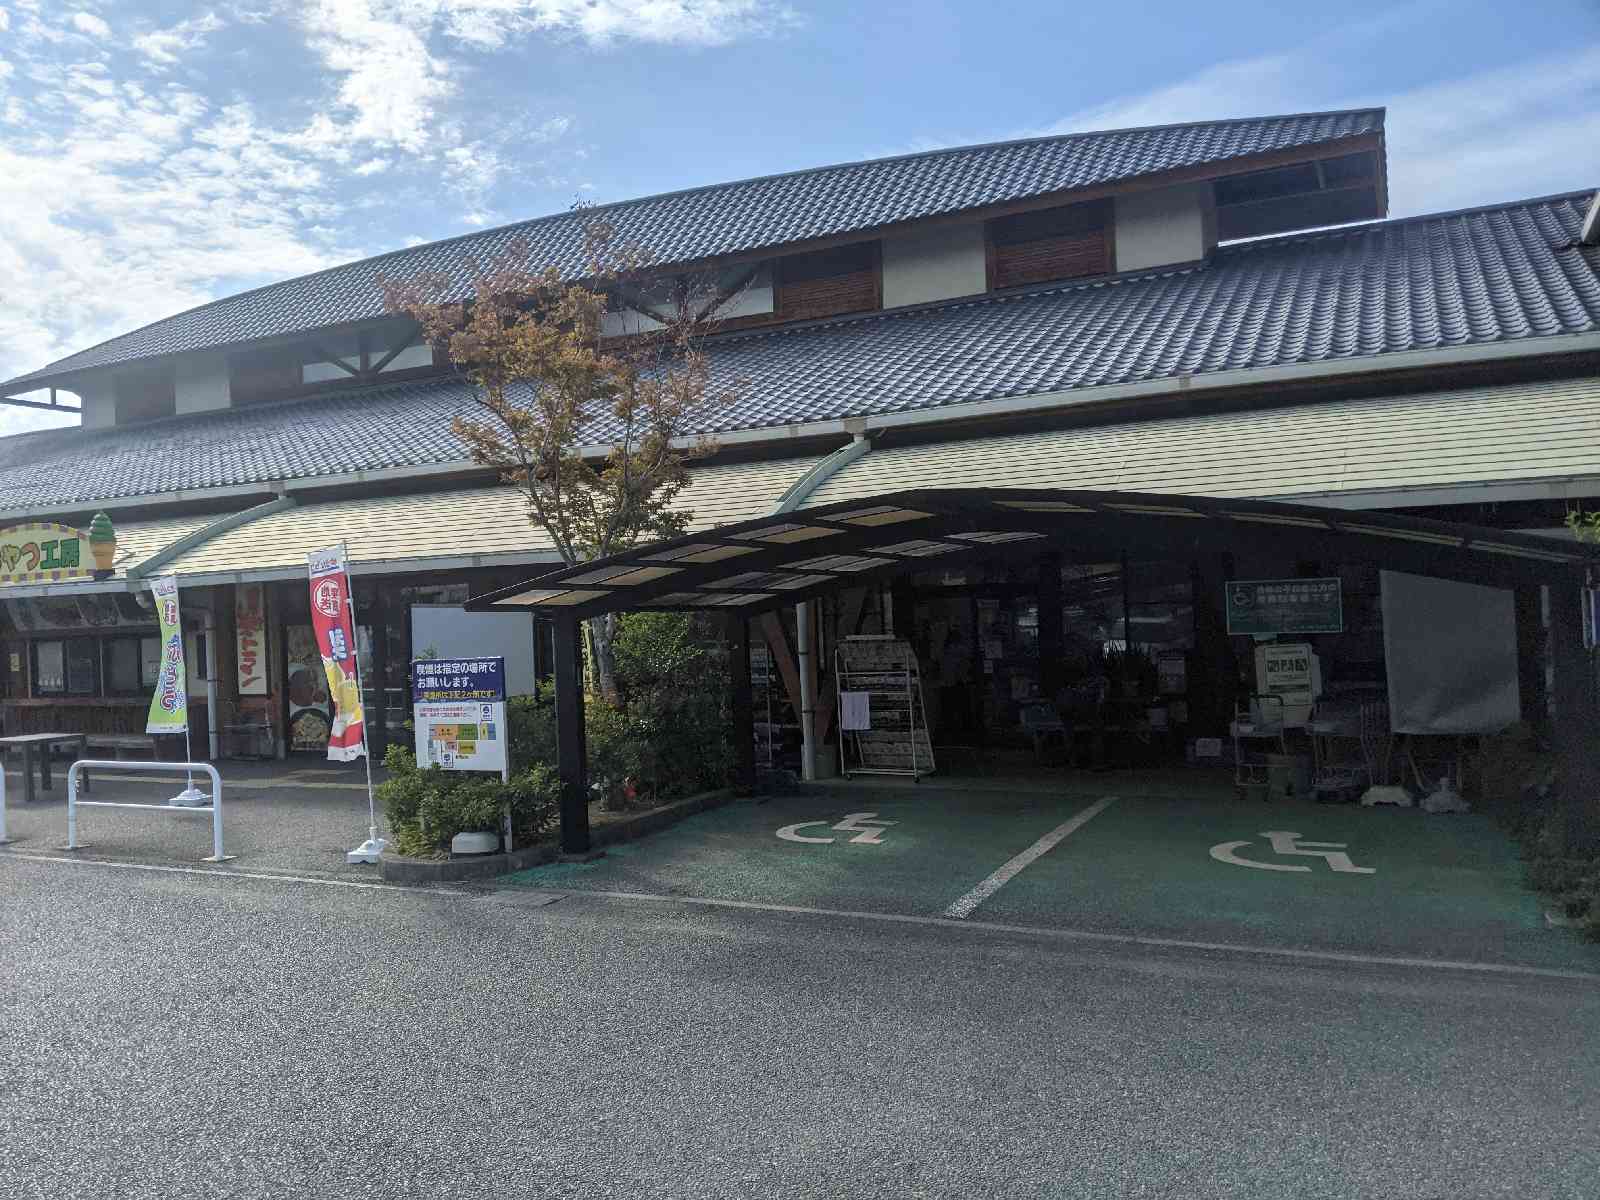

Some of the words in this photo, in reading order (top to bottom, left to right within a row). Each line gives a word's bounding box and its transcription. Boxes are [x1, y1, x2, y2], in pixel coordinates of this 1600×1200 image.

[0, 538, 80, 572] やつ工房
[416, 662, 496, 675] 喫煙は指定の場所で
[417, 676, 474, 688] お願いします。
